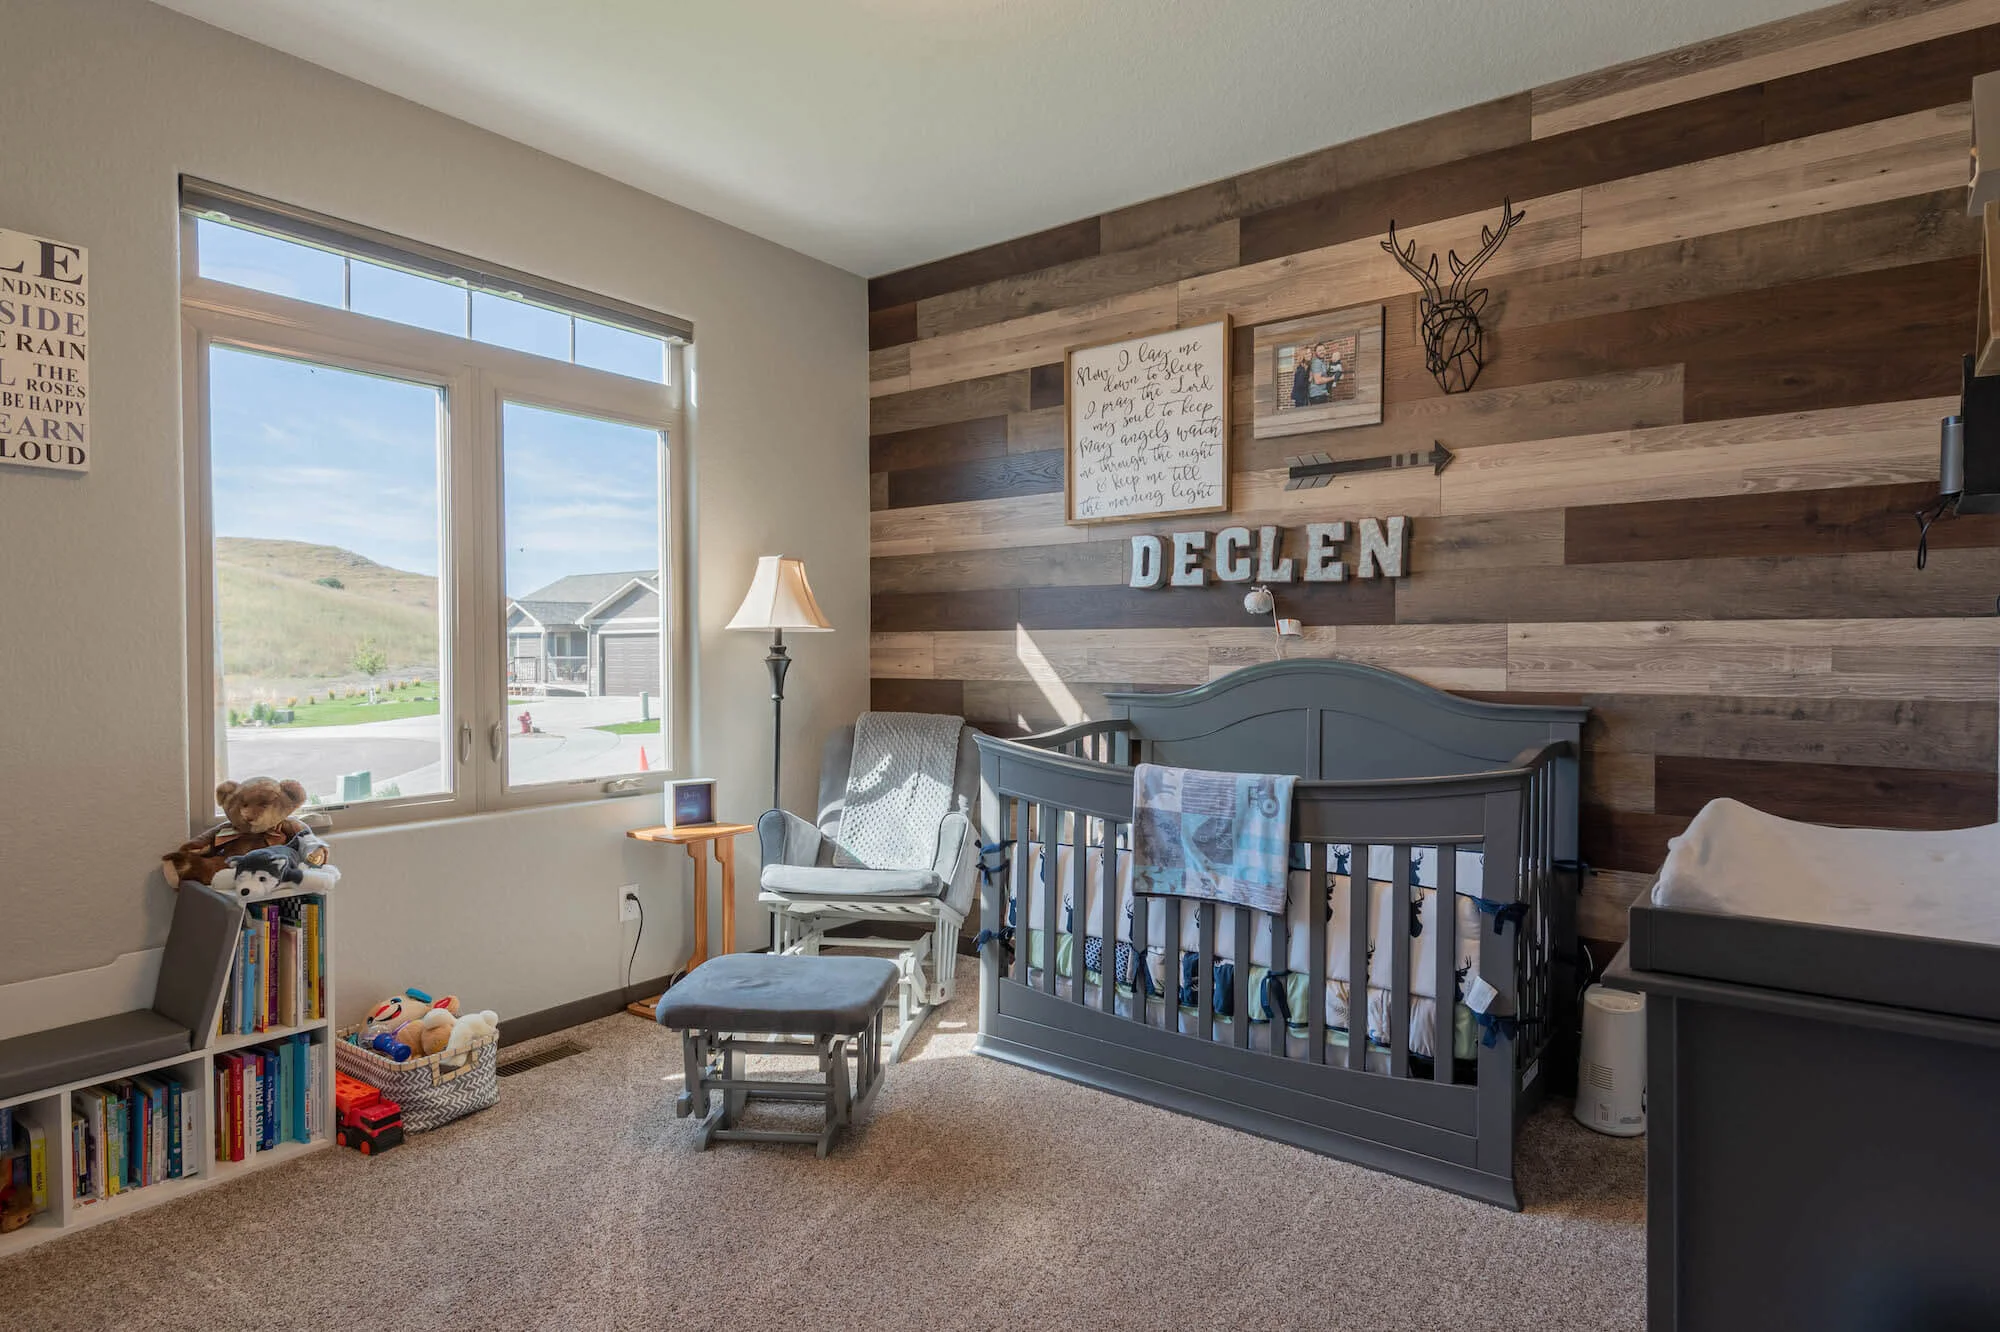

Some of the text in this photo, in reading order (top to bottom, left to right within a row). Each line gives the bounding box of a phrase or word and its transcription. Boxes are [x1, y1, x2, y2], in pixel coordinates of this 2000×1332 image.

[2, 277, 86, 306] NDNESS
[0, 300, 86, 337] SIDE
[16, 333, 86, 361] RAIN
[1077, 341, 1202, 387] Now I lay me
[27, 378, 86, 398] ROSES
[33, 363, 79, 383] THE
[1104, 358, 1204, 392] down to sleep
[3, 391, 86, 417] BE HAPPY
[1084, 375, 1214, 420] I pray the Lord
[0, 413, 87, 443] EARN
[1093, 395, 1215, 437] my soul to keep
[1120, 419, 1169, 450] angels
[1177, 416, 1223, 441] watch
[0, 438, 86, 465] LOUD
[1080, 442, 1219, 480] me through the night
[1096, 464, 1201, 493] & keep me till
[1080, 482, 1220, 516] the morning light
[1129, 516, 1407, 589] DECLEN
